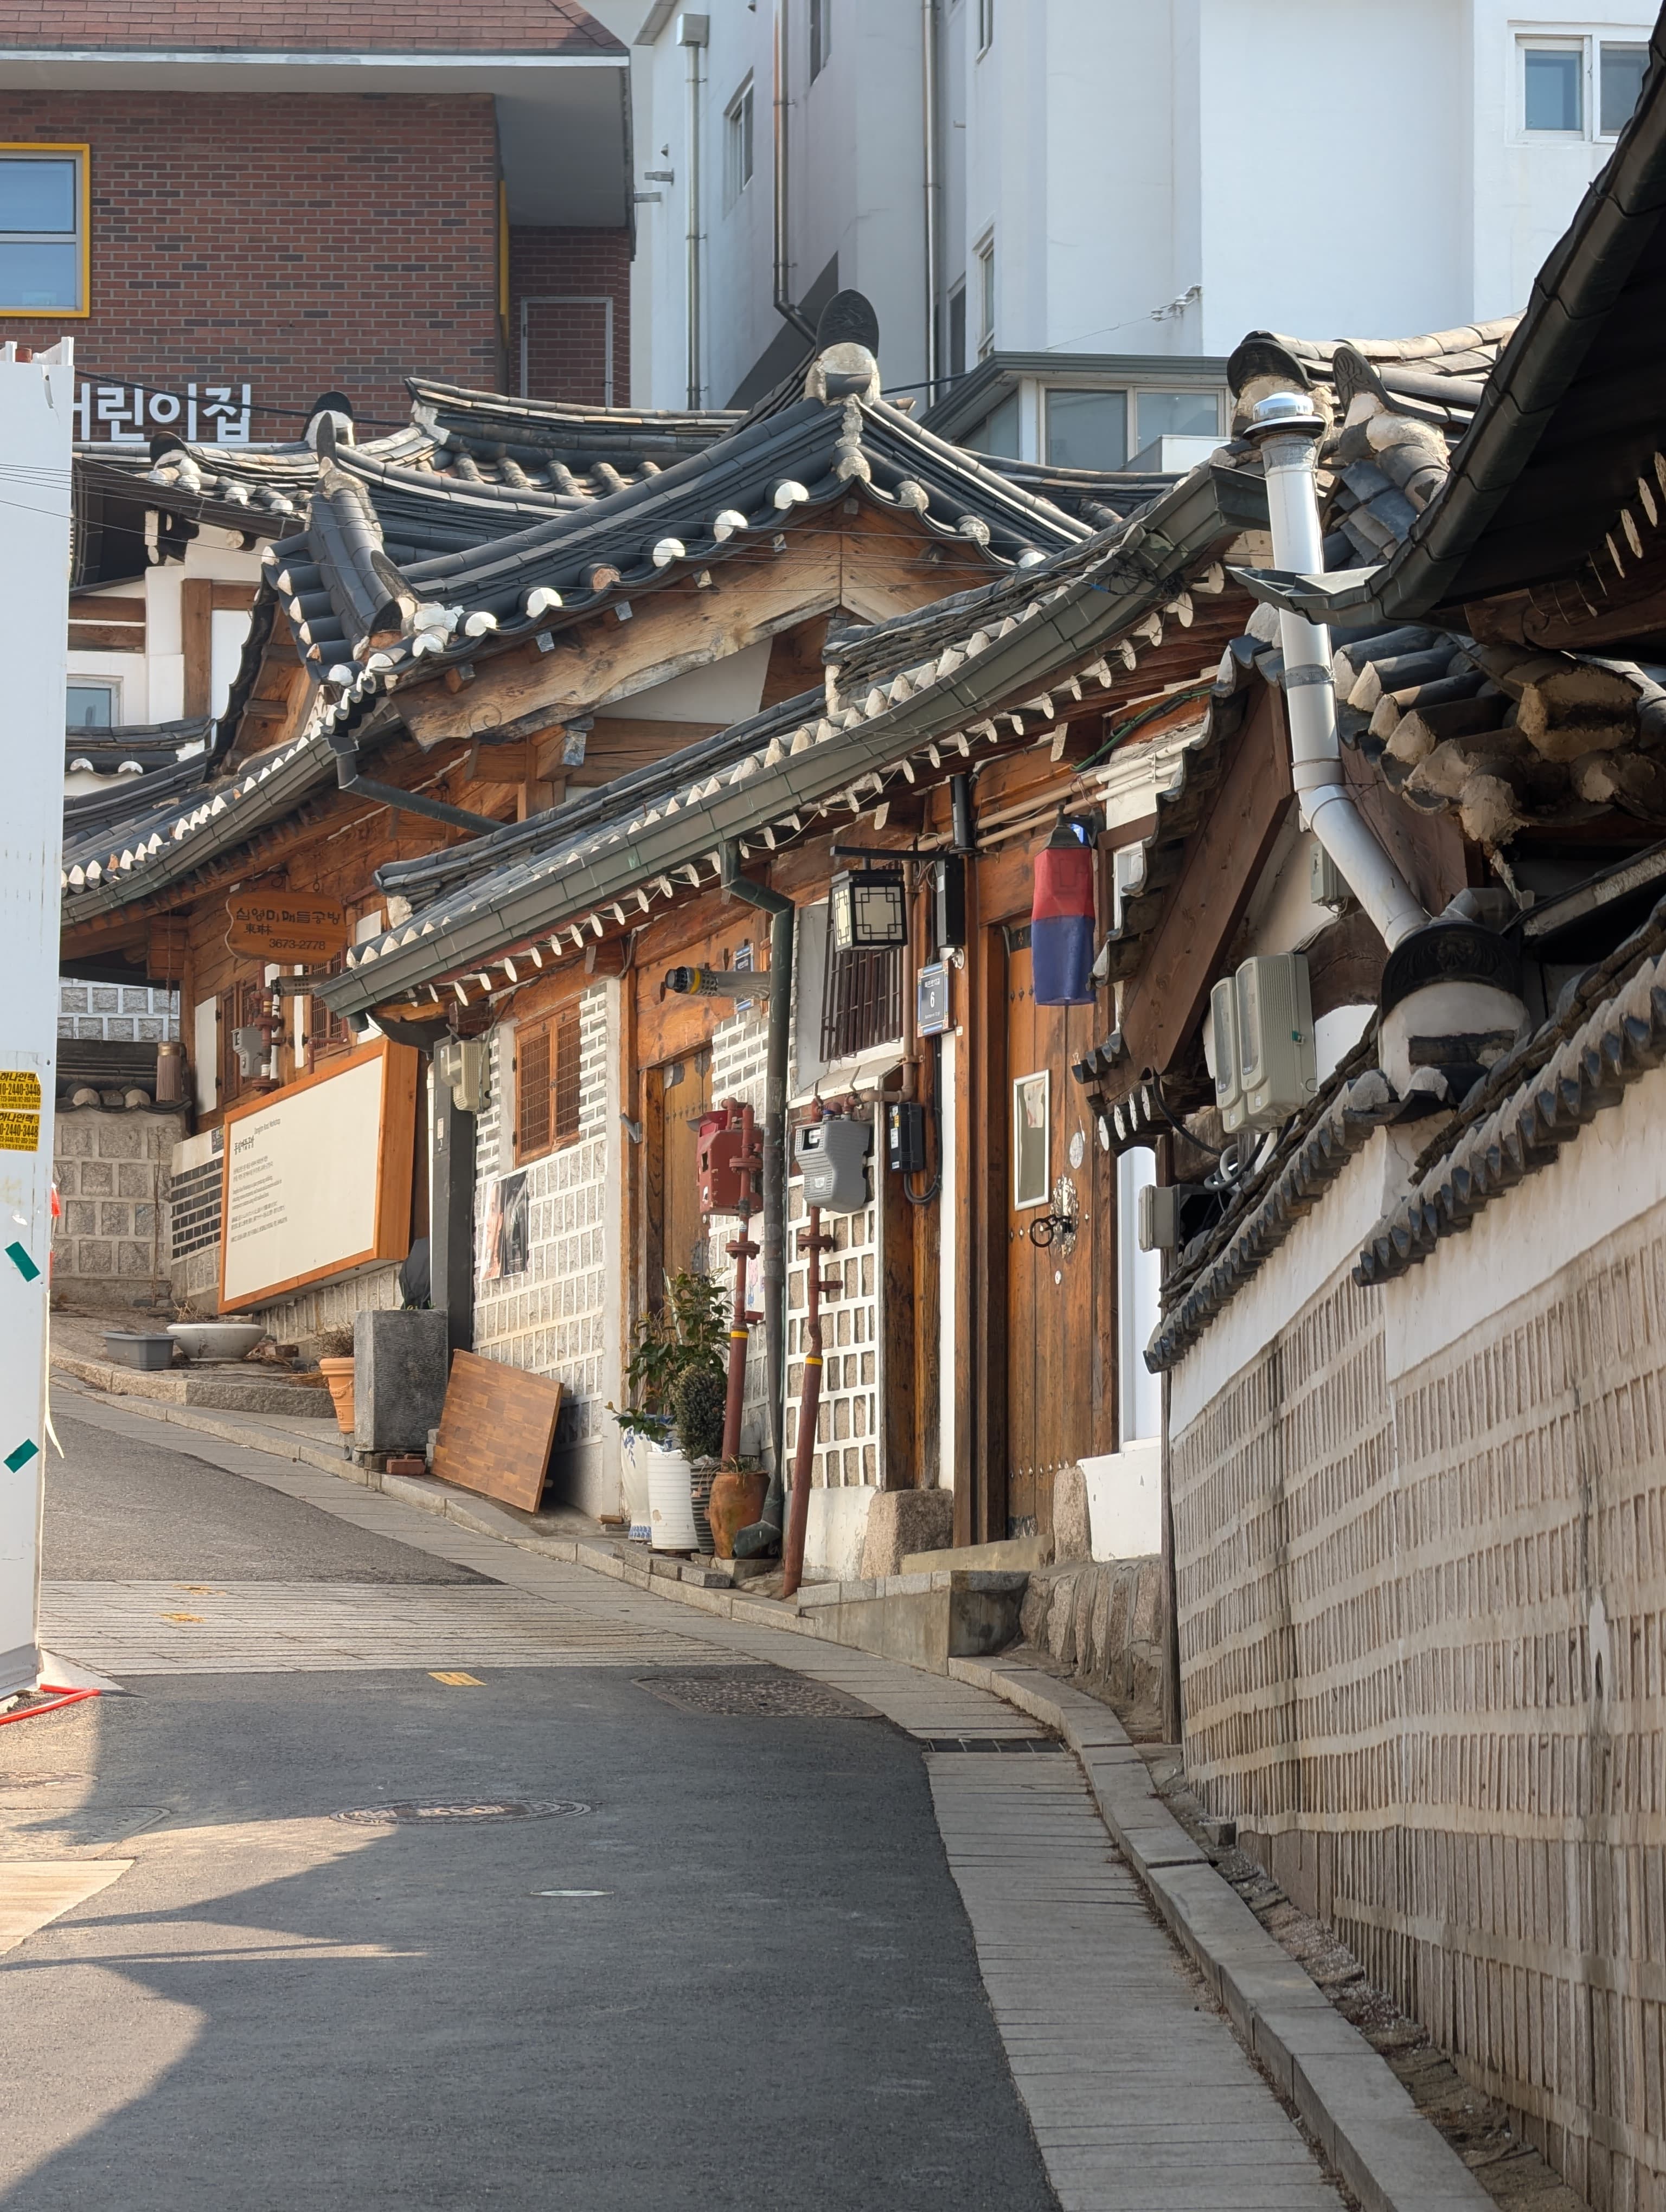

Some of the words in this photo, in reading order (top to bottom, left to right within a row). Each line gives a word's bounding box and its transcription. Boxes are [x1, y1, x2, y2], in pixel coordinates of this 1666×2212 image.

[269, 938, 325, 950] 3673-2778
[930, 991, 935, 1008] 6
[0, 1072, 36, 1082] 하나인력
